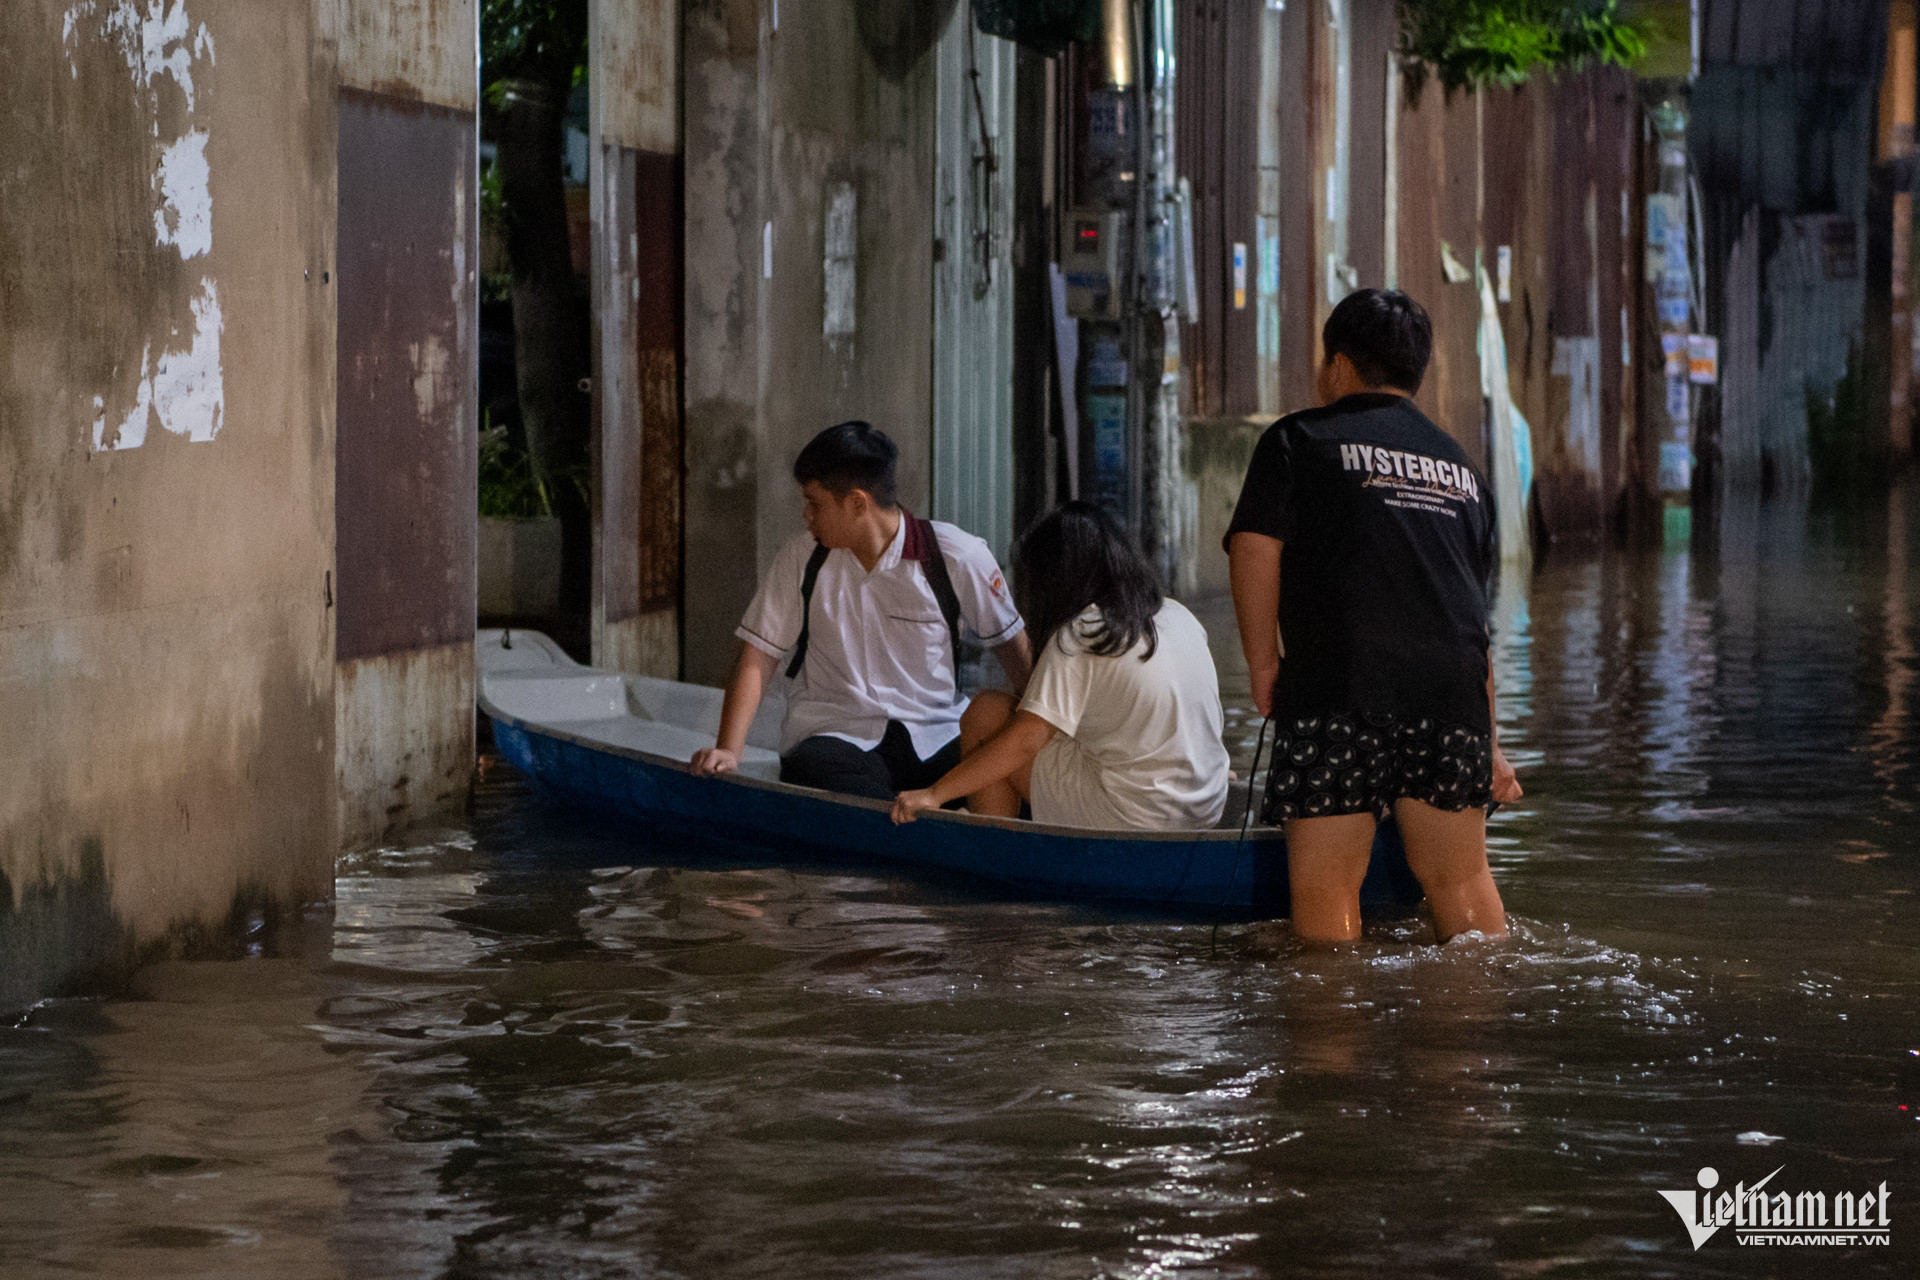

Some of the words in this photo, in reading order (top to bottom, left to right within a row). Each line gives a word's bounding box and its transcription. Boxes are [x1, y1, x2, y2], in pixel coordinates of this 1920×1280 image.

[1397, 491, 1445, 504] EXTRAORDINARY
[1384, 499, 1402, 508] MAKE
[1402, 501, 1420, 510] SOME
[1420, 503, 1440, 513] CRAZY
[1440, 507, 1457, 519] NOISE
